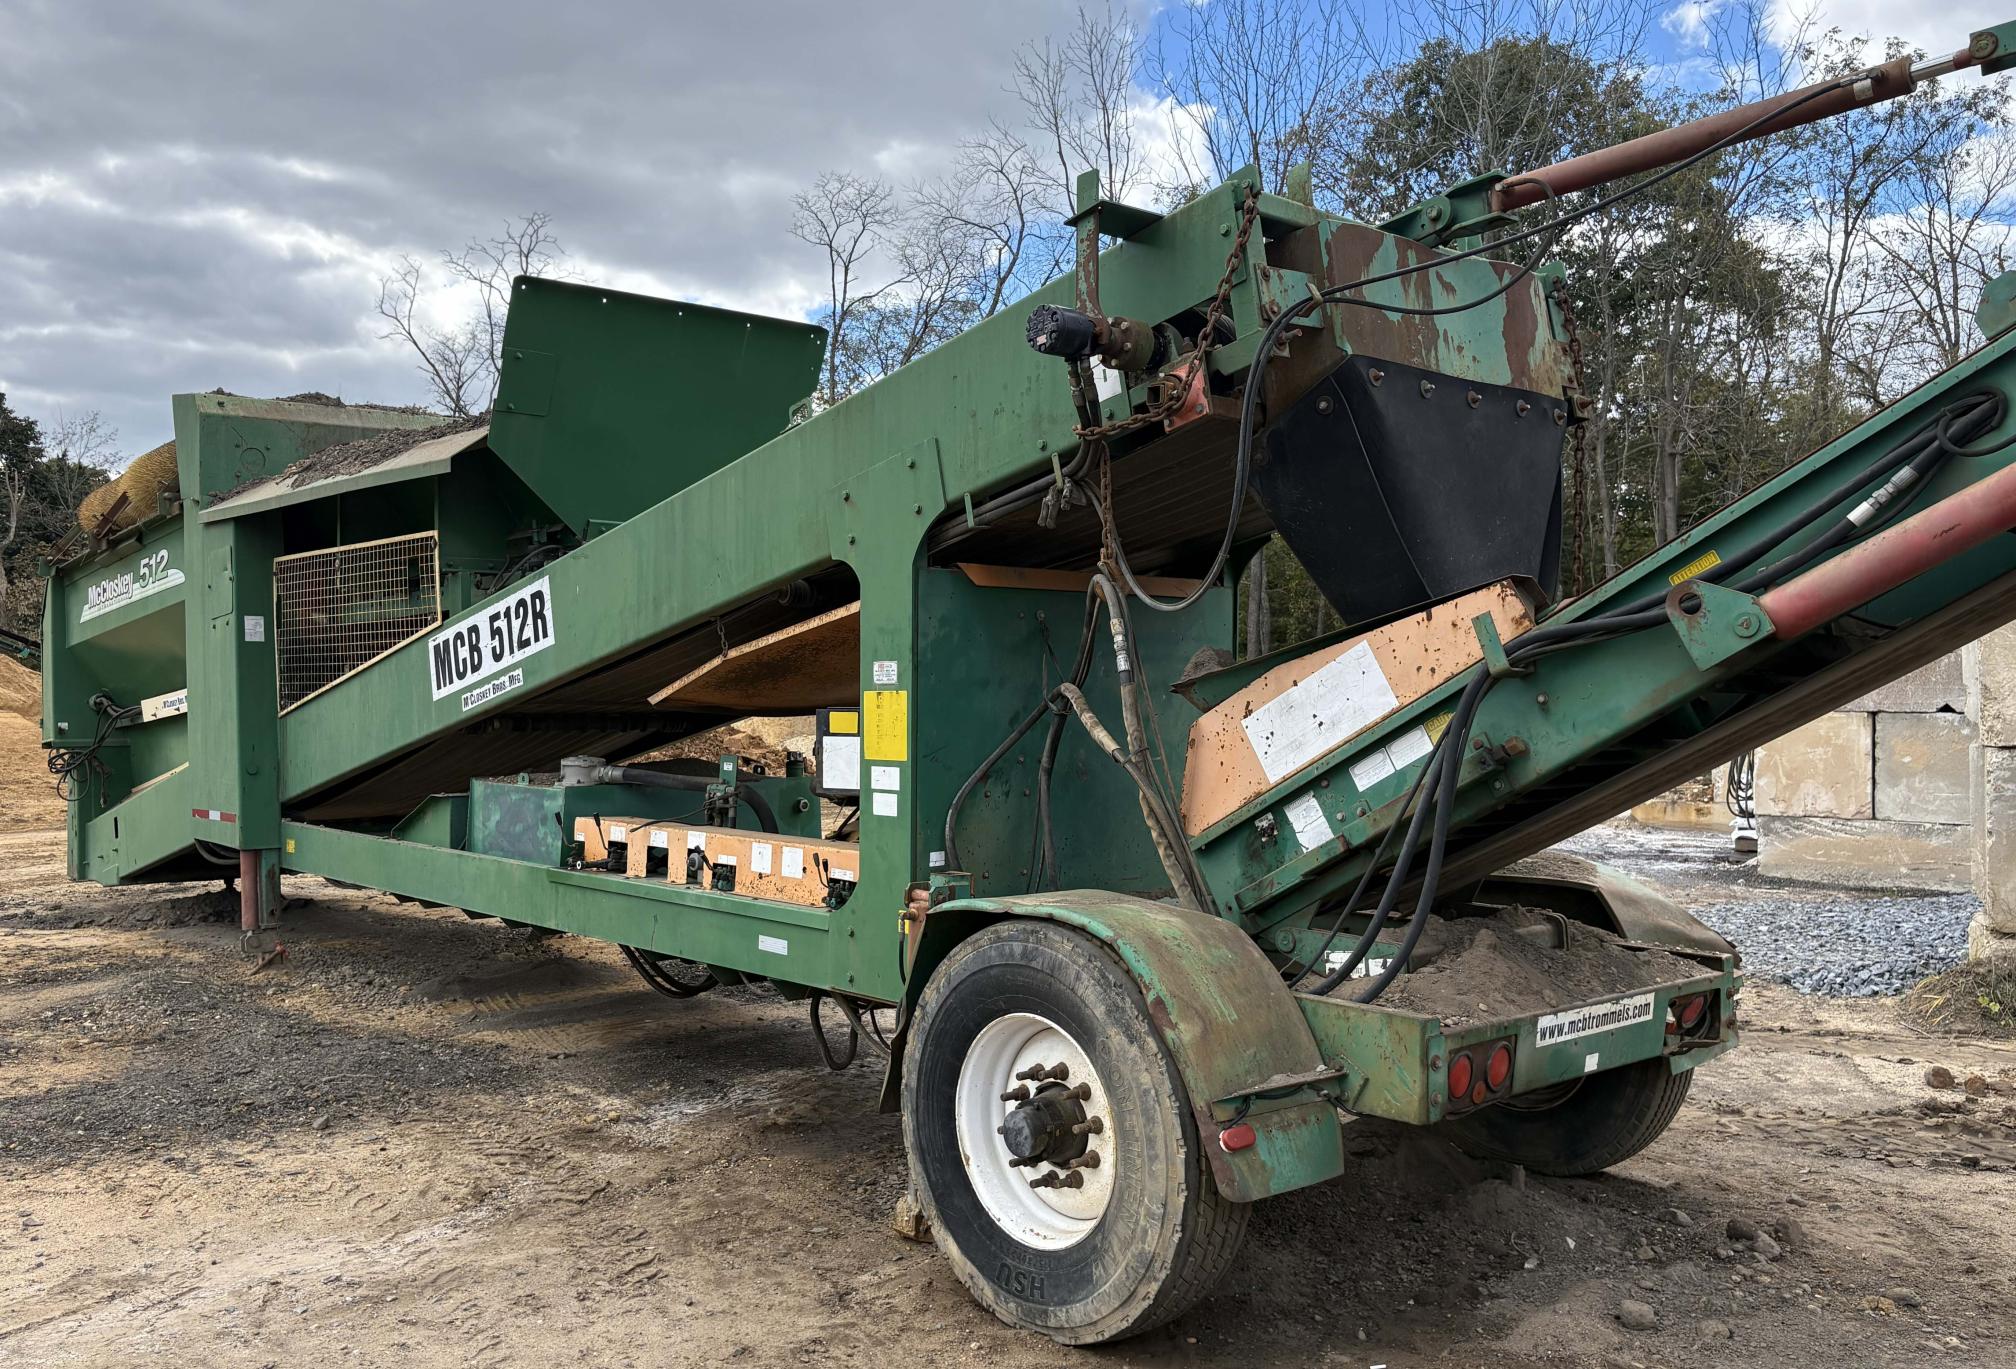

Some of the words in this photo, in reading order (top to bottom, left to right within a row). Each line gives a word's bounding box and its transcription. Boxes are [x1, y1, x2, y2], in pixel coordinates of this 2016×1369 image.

[88, 572, 134, 610] McCloskey
[140, 549, 169, 588] 512
[1673, 553, 1717, 584] ATTENTION
[433, 624, 483, 691] MCB
[489, 589, 549, 663] 512R
[1540, 1002, 1651, 1041] www.mcbtrommels.com
